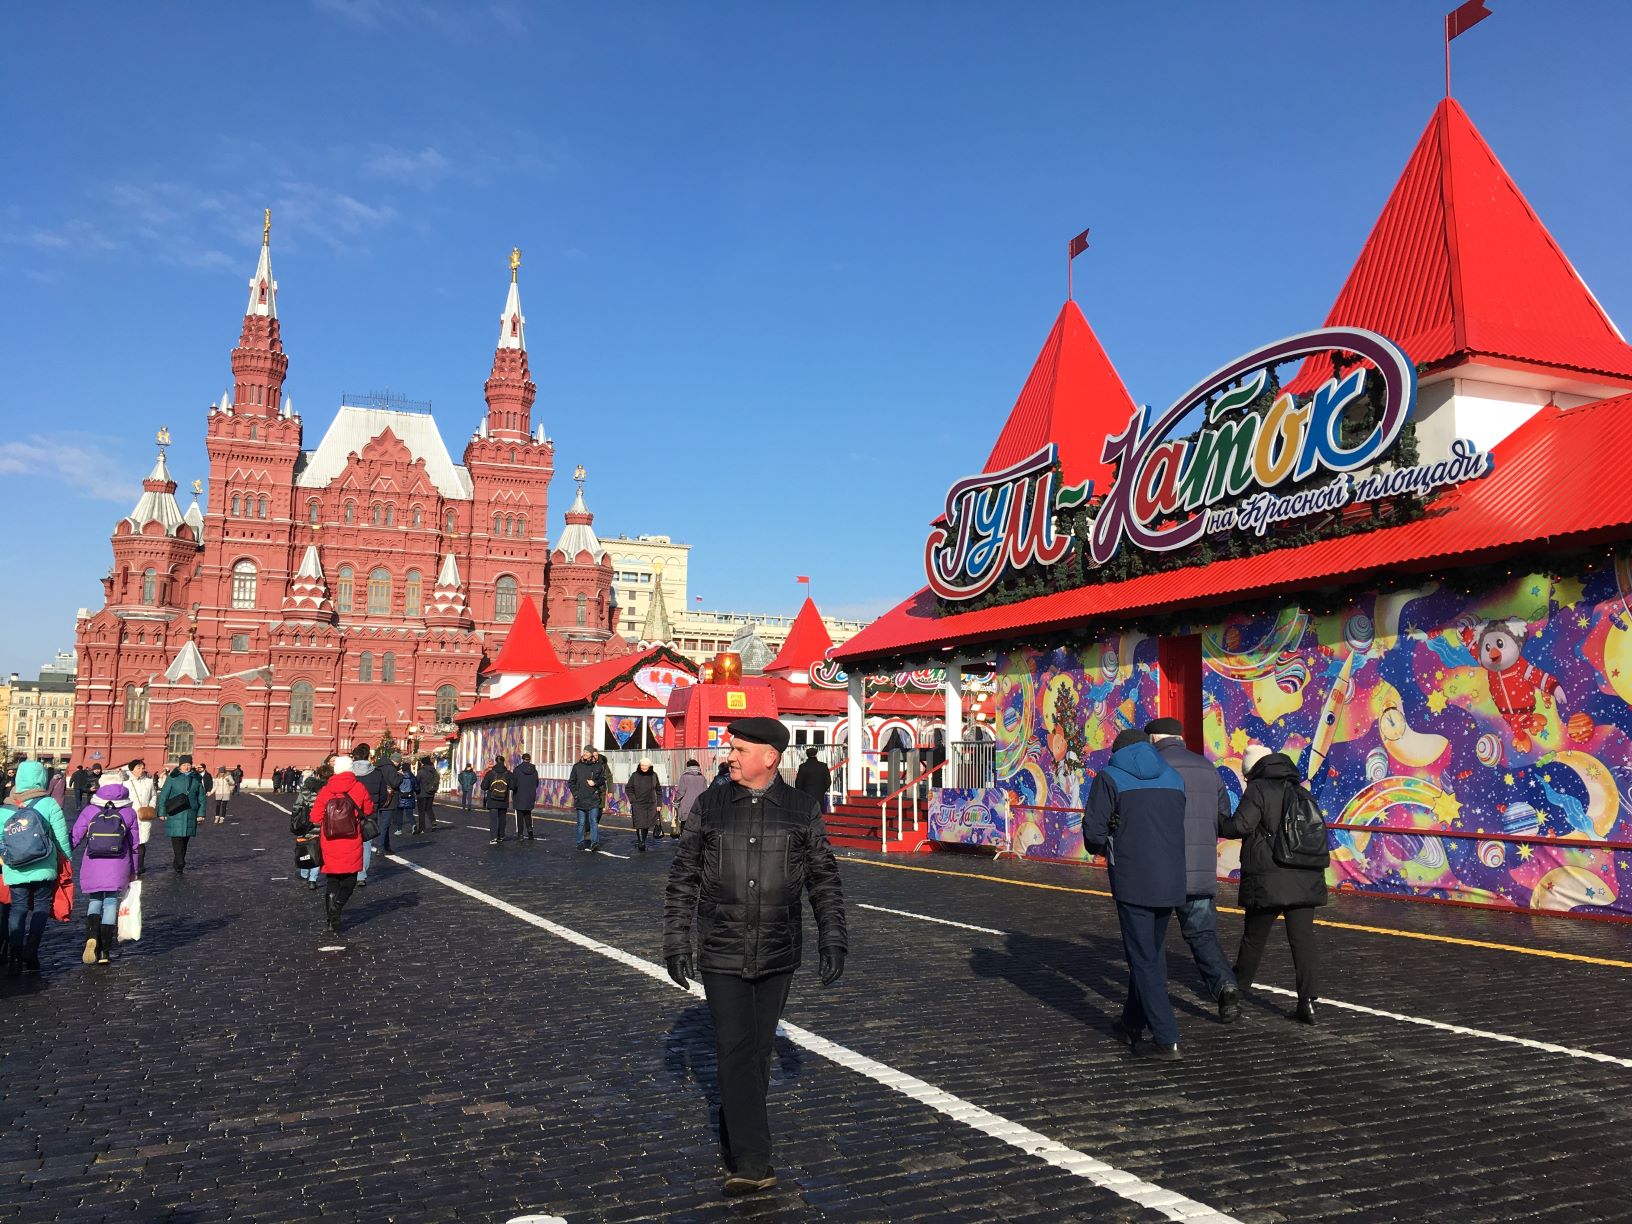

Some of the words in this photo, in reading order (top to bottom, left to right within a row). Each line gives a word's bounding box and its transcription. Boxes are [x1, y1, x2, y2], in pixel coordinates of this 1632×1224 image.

[1209, 511, 1237, 534] на
[1239, 473, 1349, 536] Красной
[1355, 439, 1488, 502] площади
[8, 825, 27, 836] LOVE
